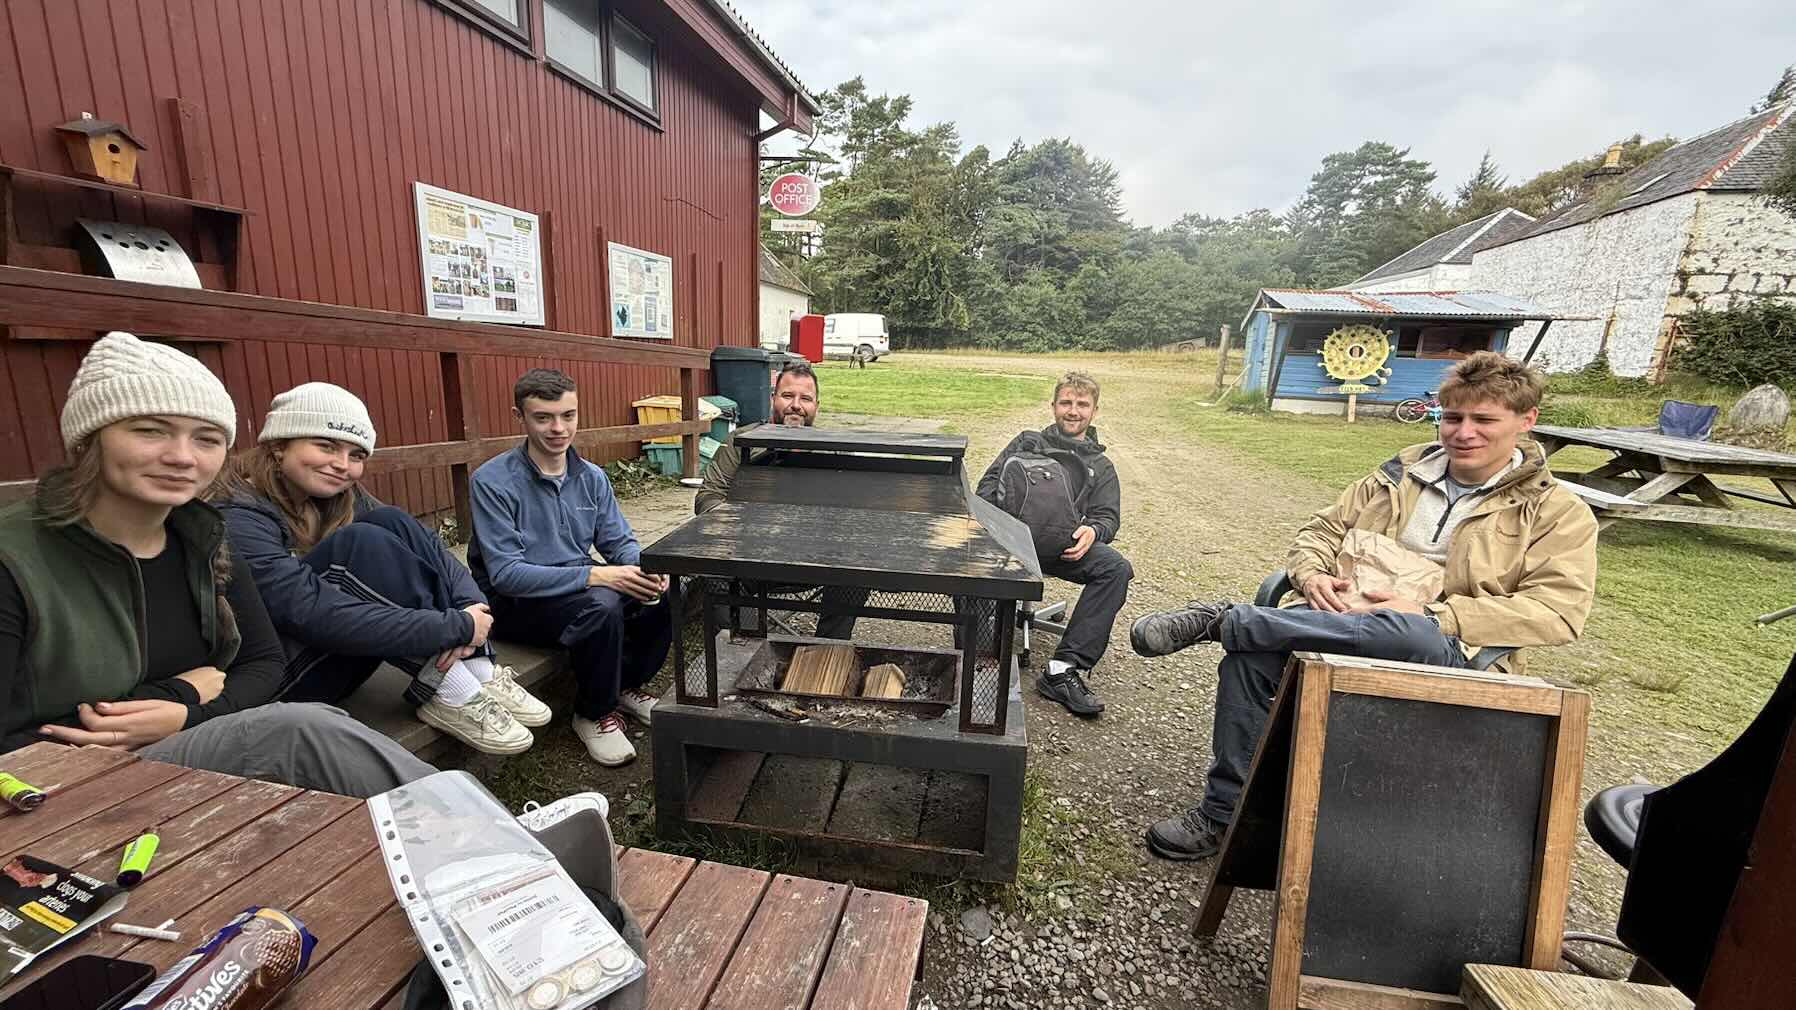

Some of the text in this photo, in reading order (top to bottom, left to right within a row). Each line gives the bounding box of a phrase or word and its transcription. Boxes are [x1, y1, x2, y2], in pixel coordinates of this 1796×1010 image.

[781, 182, 808, 193] POST
[775, 194, 812, 205] OFFICE
[56, 880, 94, 903] clogs your
[38, 895, 71, 913] arteries
[188, 960, 241, 1010] tives
